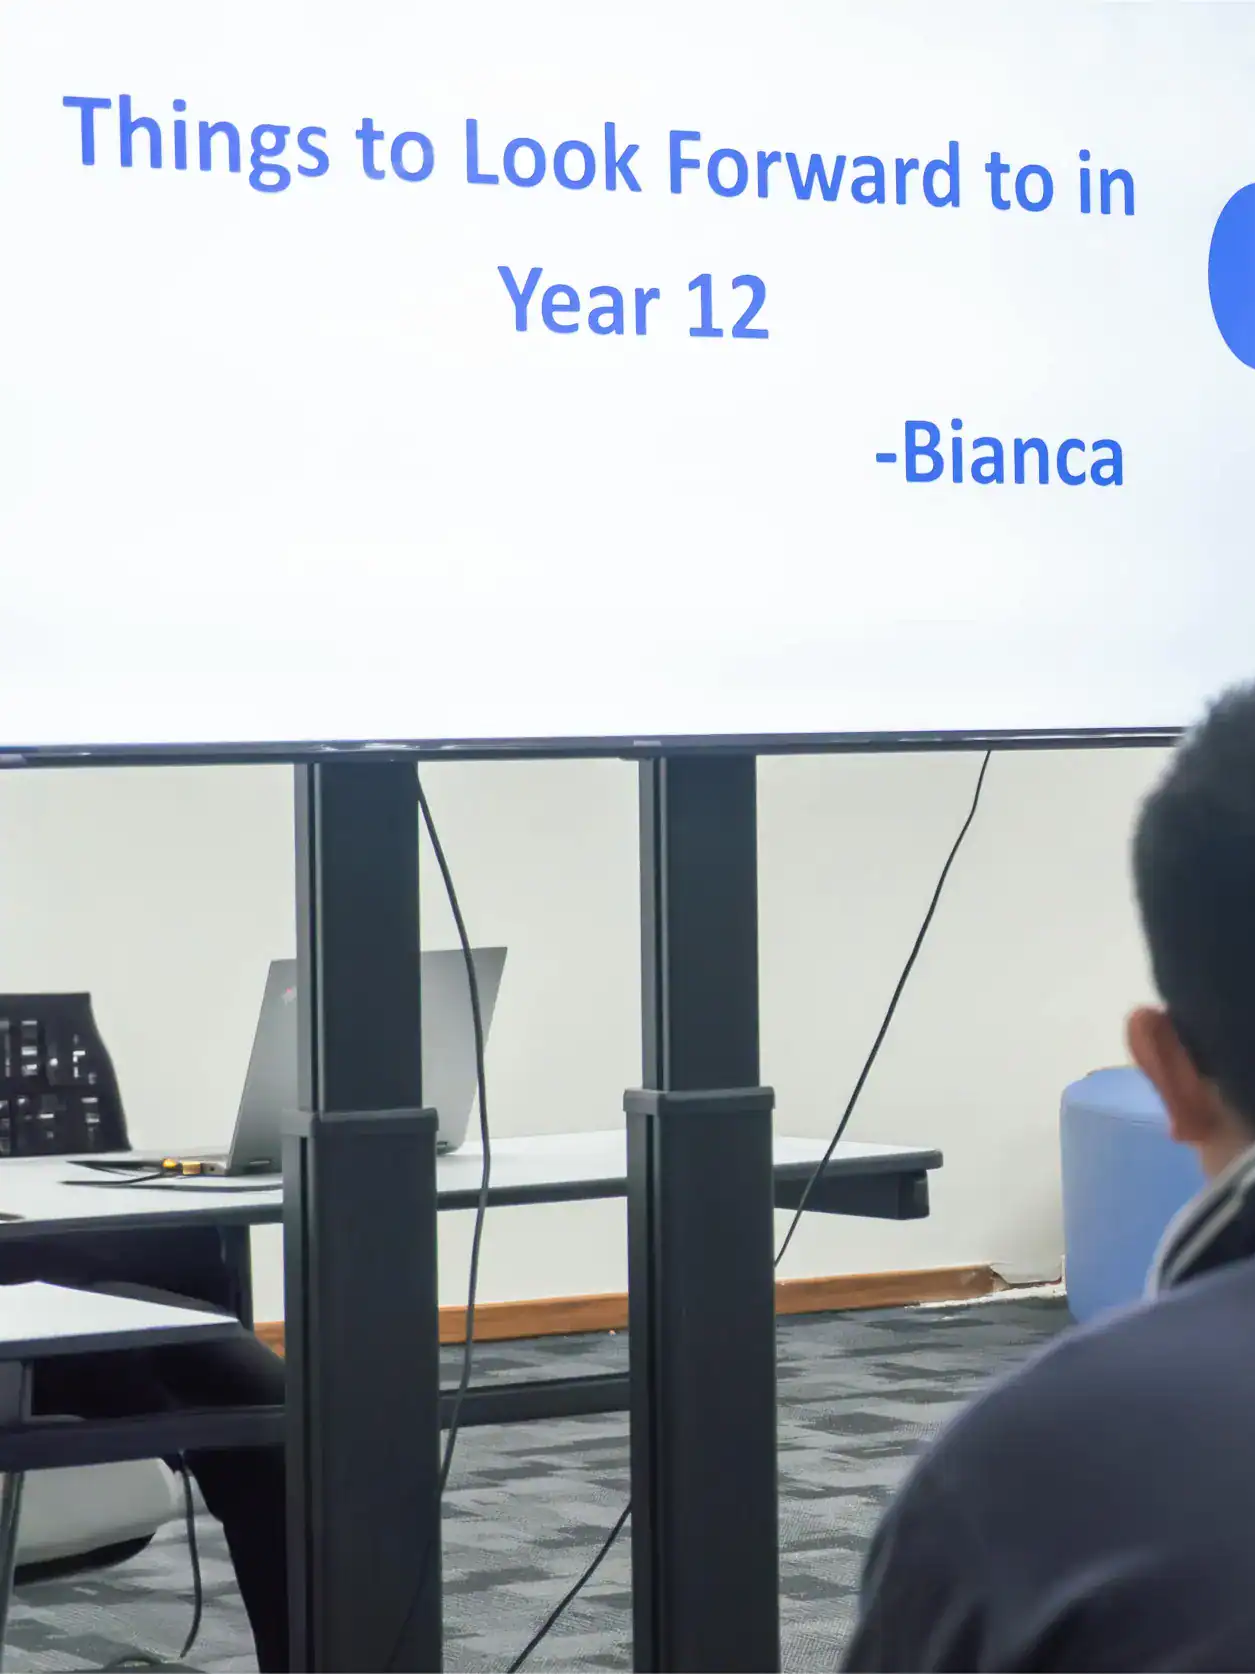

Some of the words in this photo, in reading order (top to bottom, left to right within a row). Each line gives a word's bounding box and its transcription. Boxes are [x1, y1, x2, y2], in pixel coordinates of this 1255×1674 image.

[62, 93, 330, 194] Things
[355, 117, 435, 183] to
[465, 118, 642, 193] Look
[668, 129, 961, 208] Forward
[984, 151, 1055, 213] to
[1078, 149, 1136, 217] in
[497, 265, 661, 337] Year
[687, 273, 770, 340] 12
[875, 418, 1124, 488] -Bianca
